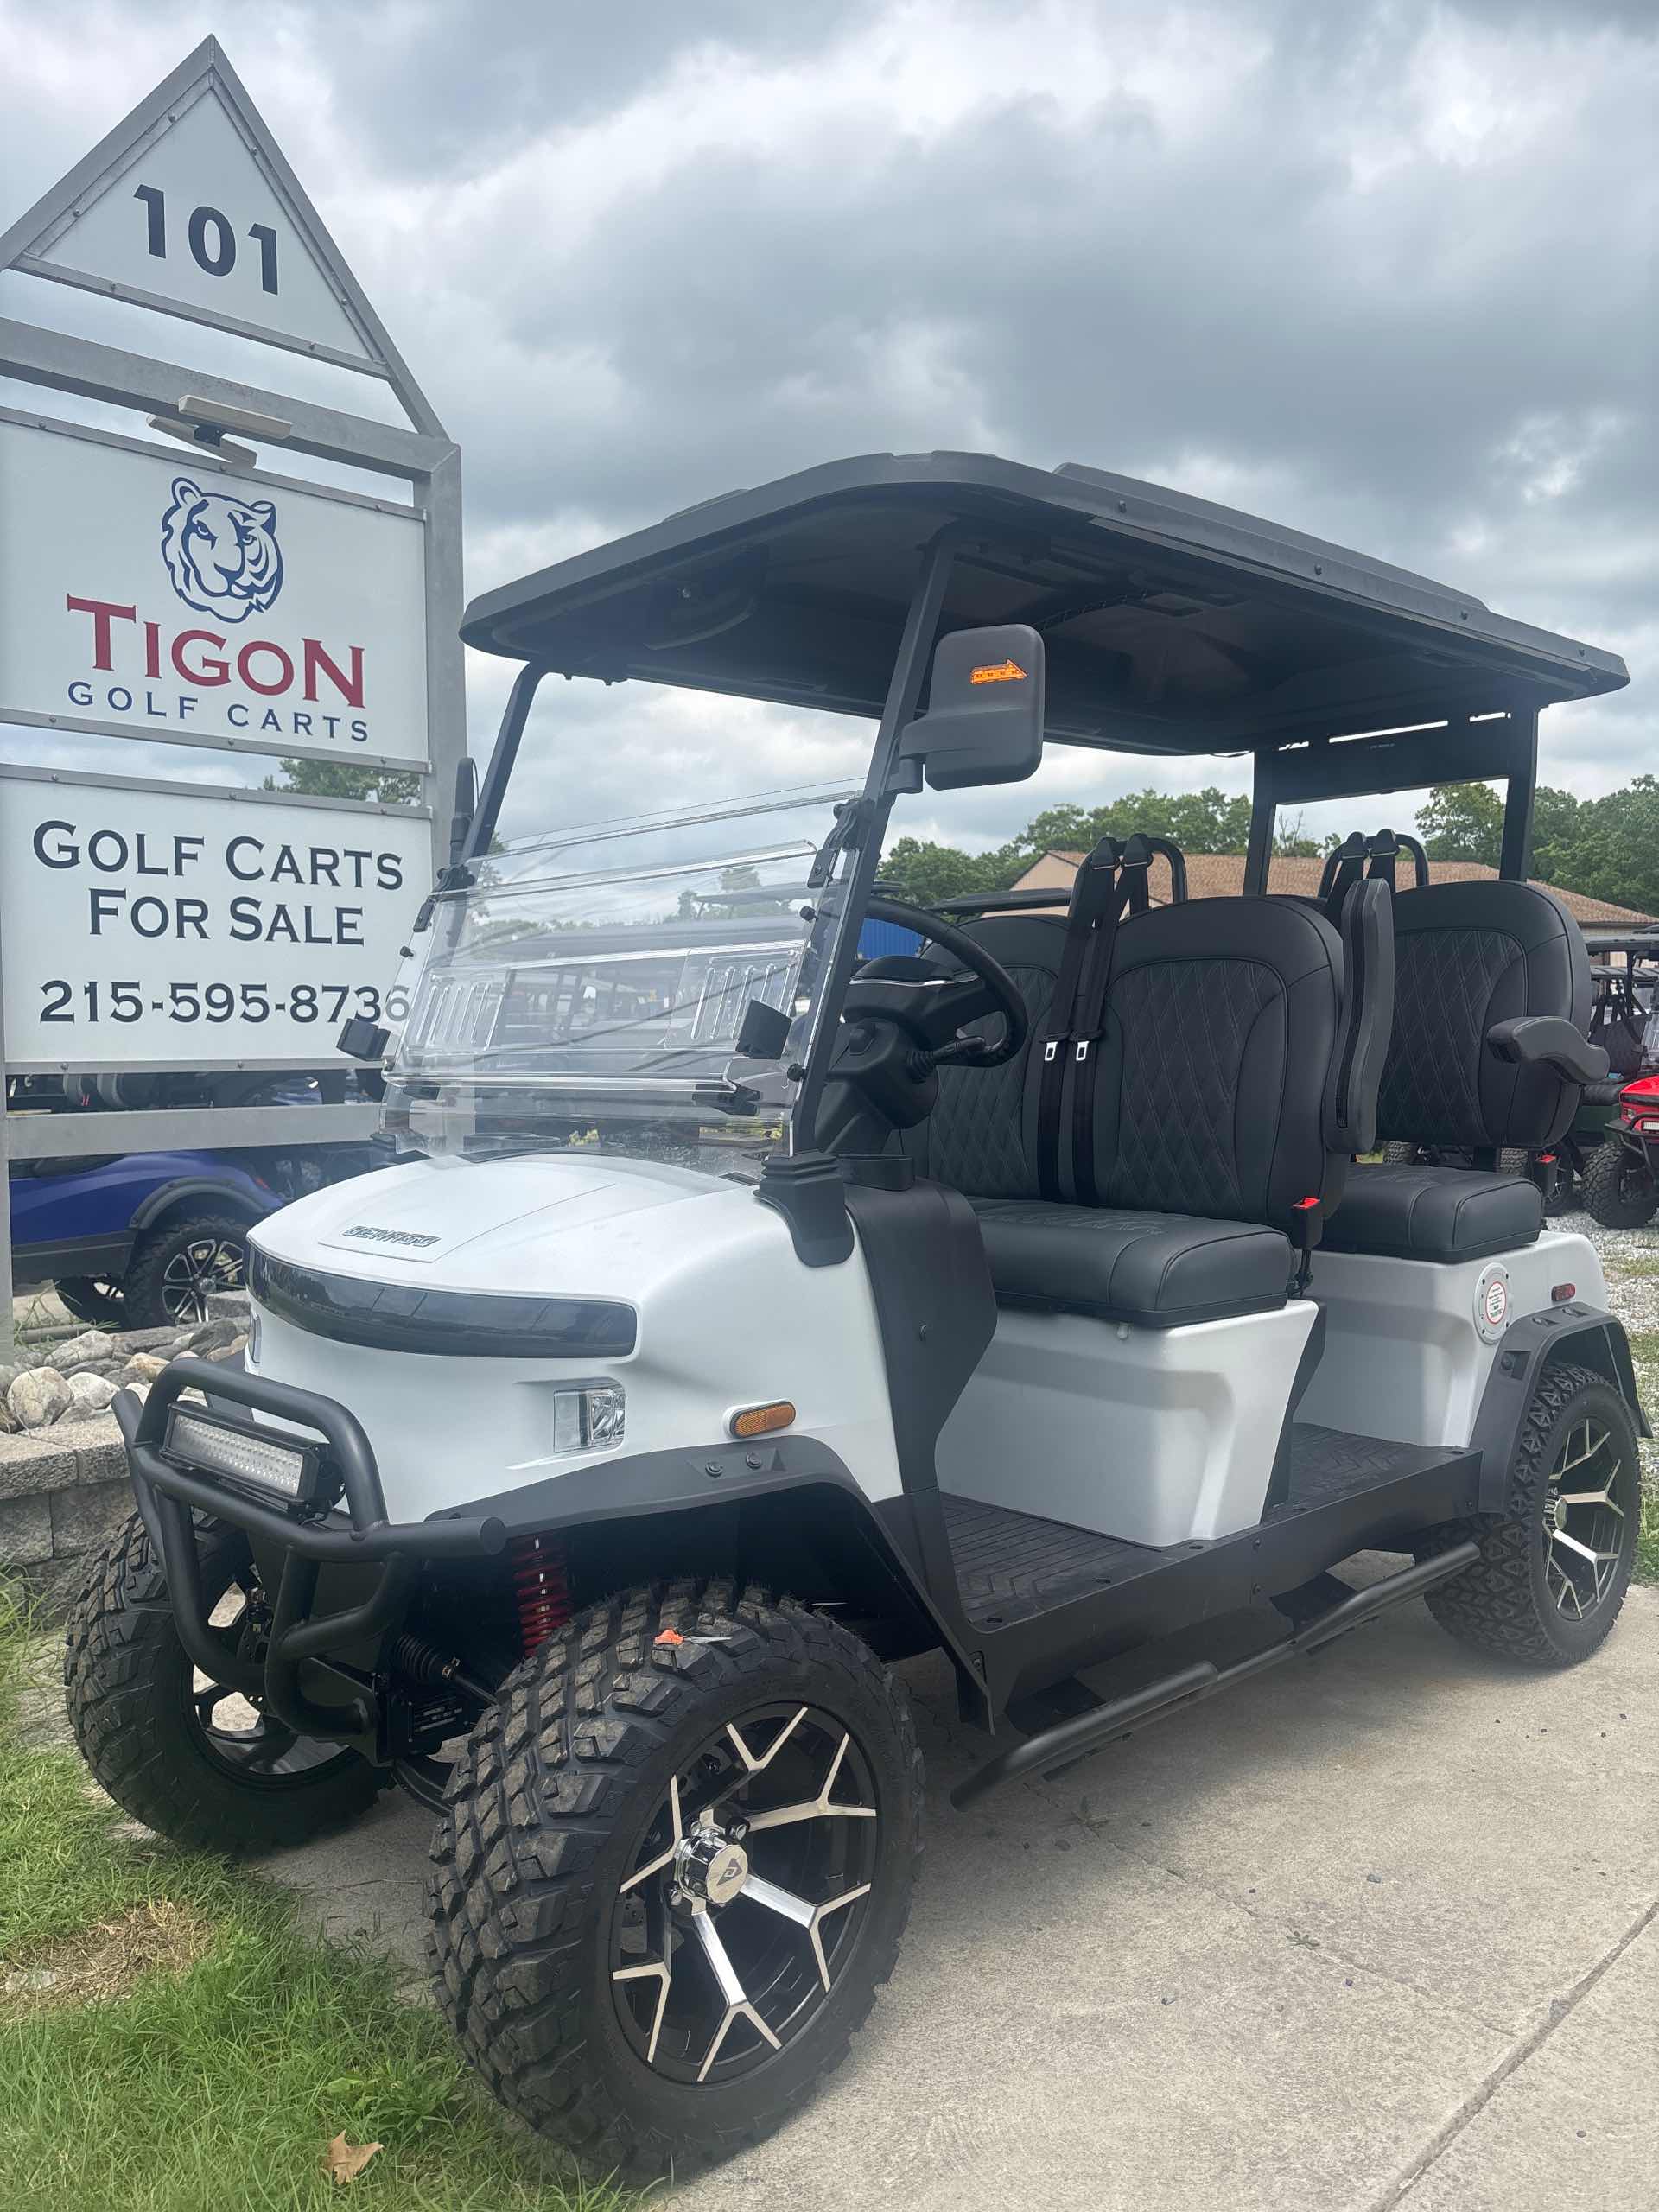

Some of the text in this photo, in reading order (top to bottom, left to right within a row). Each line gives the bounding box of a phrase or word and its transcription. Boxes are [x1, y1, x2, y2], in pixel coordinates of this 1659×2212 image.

[133, 184, 278, 296] 101
[67, 593, 365, 709] TIGON
[67, 681, 368, 742] GOLF CARTS
[33, 820, 403, 891] GOLF CARTS
[88, 887, 365, 947] FOR SALE
[40, 980, 410, 1023] 215-595-8736
